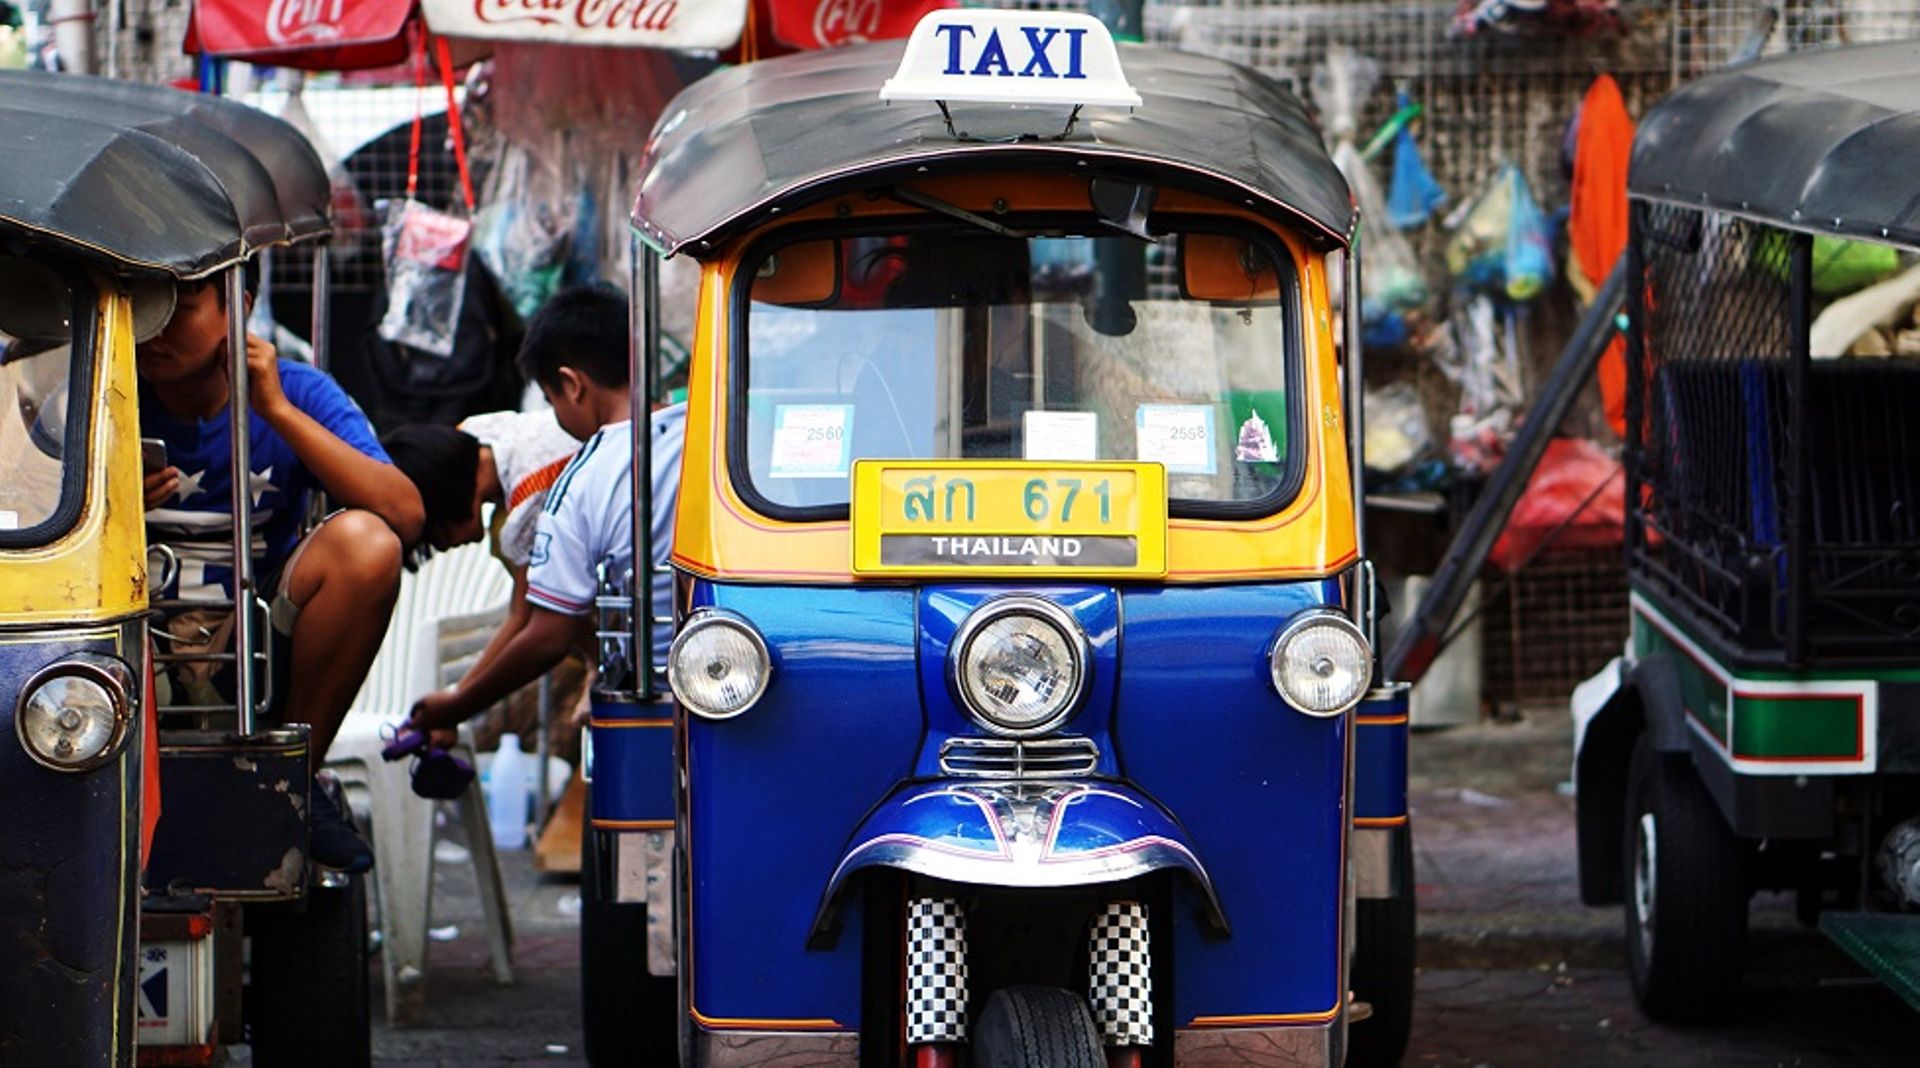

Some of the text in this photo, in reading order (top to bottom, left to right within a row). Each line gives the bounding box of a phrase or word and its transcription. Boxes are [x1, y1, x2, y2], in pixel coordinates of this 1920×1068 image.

[935, 24, 1088, 79] TAXI
[807, 426, 844, 441] 2560
[1169, 425, 1207, 441] 2558
[903, 474, 1112, 523] สก 671
[931, 537, 1082, 557] THAILAND
